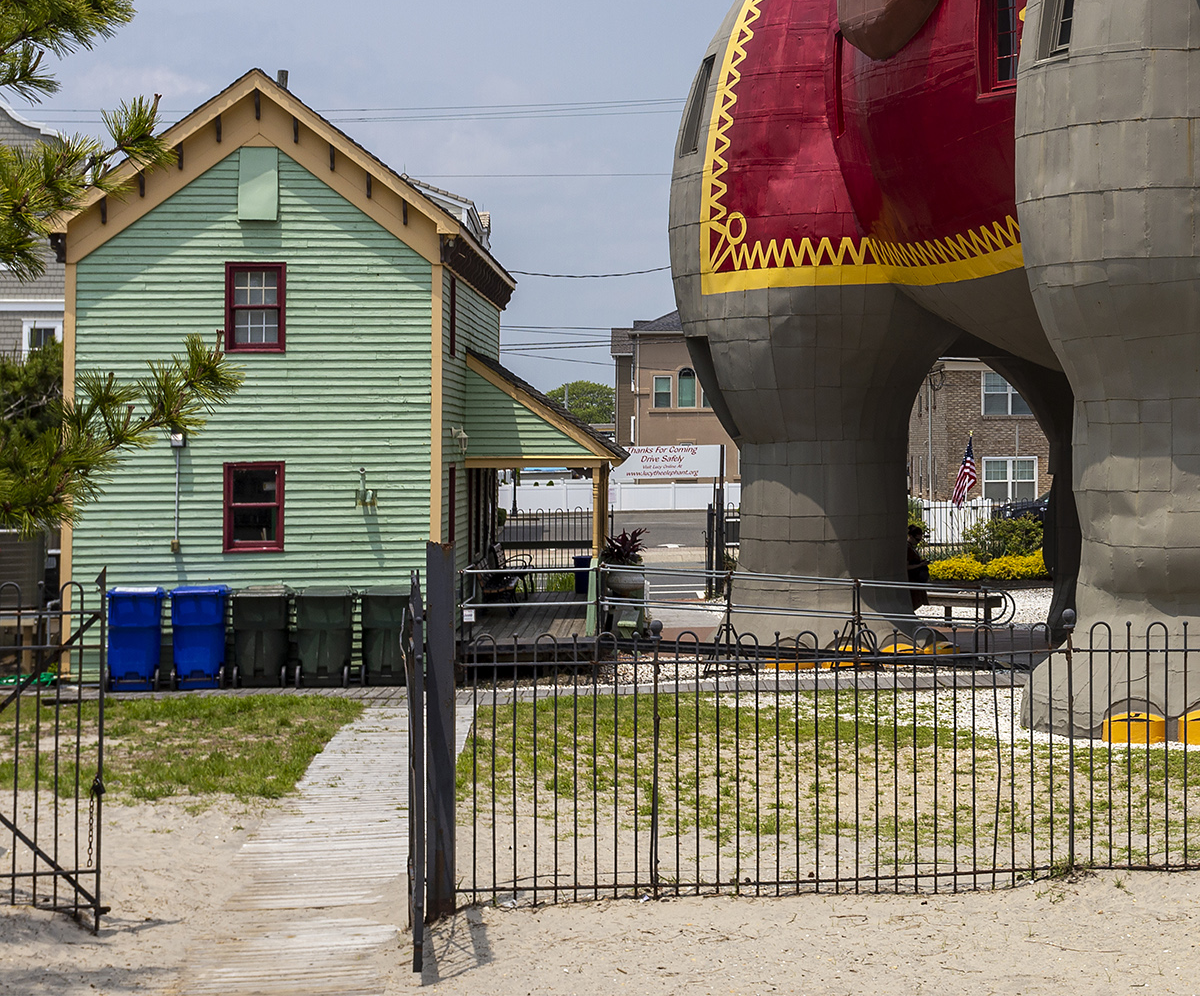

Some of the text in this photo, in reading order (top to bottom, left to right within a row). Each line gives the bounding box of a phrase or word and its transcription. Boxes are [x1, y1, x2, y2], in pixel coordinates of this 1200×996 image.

[628, 446, 698, 455] Thanks For Coming
[661, 454, 684, 463] Safely
